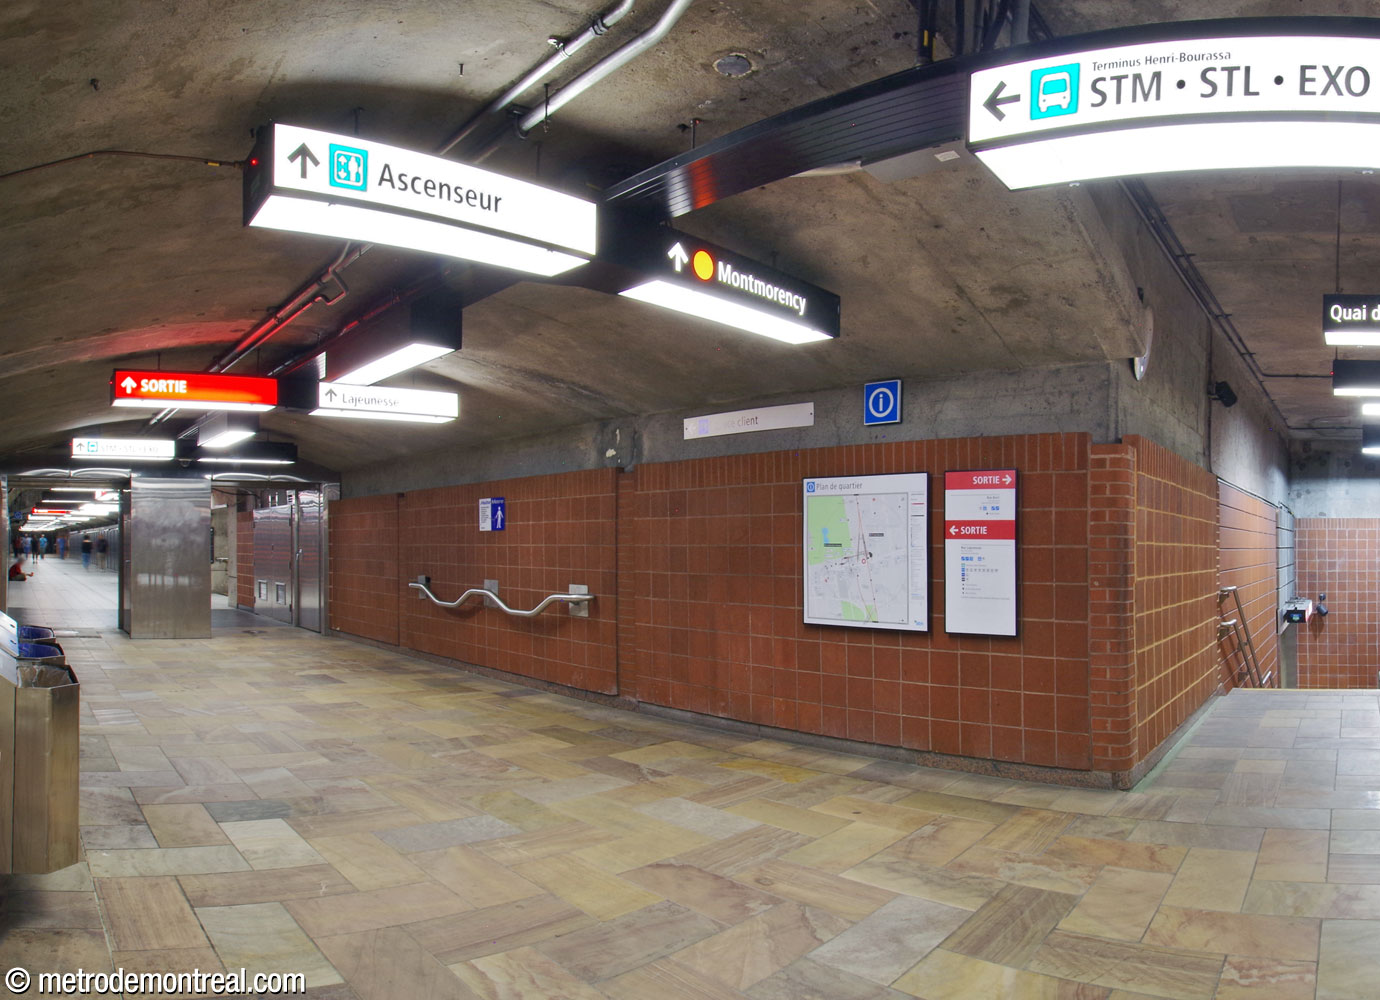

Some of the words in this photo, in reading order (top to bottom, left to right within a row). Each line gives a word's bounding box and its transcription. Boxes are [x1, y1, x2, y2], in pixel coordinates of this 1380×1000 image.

[1092, 58, 1141, 71] Terminus
[1144, 50, 1232, 66] Henri-Bourassa
[1090, 71, 1162, 108] STM
[1200, 65, 1260, 98] STL
[1299, 65, 1371, 97] EXO
[378, 163, 501, 213] Ascenseur
[717, 261, 807, 316] Montmorency
[1330, 305, 1367, 322] Quai
[140, 378, 187, 394] SORTIE
[342, 393, 400, 407] Lajeunesse
[816, 483, 829, 491] Plan
[838, 482, 862, 491] quartier
[972, 475, 1000, 485] SORTIE
[960, 526, 988, 535] SORTIE
